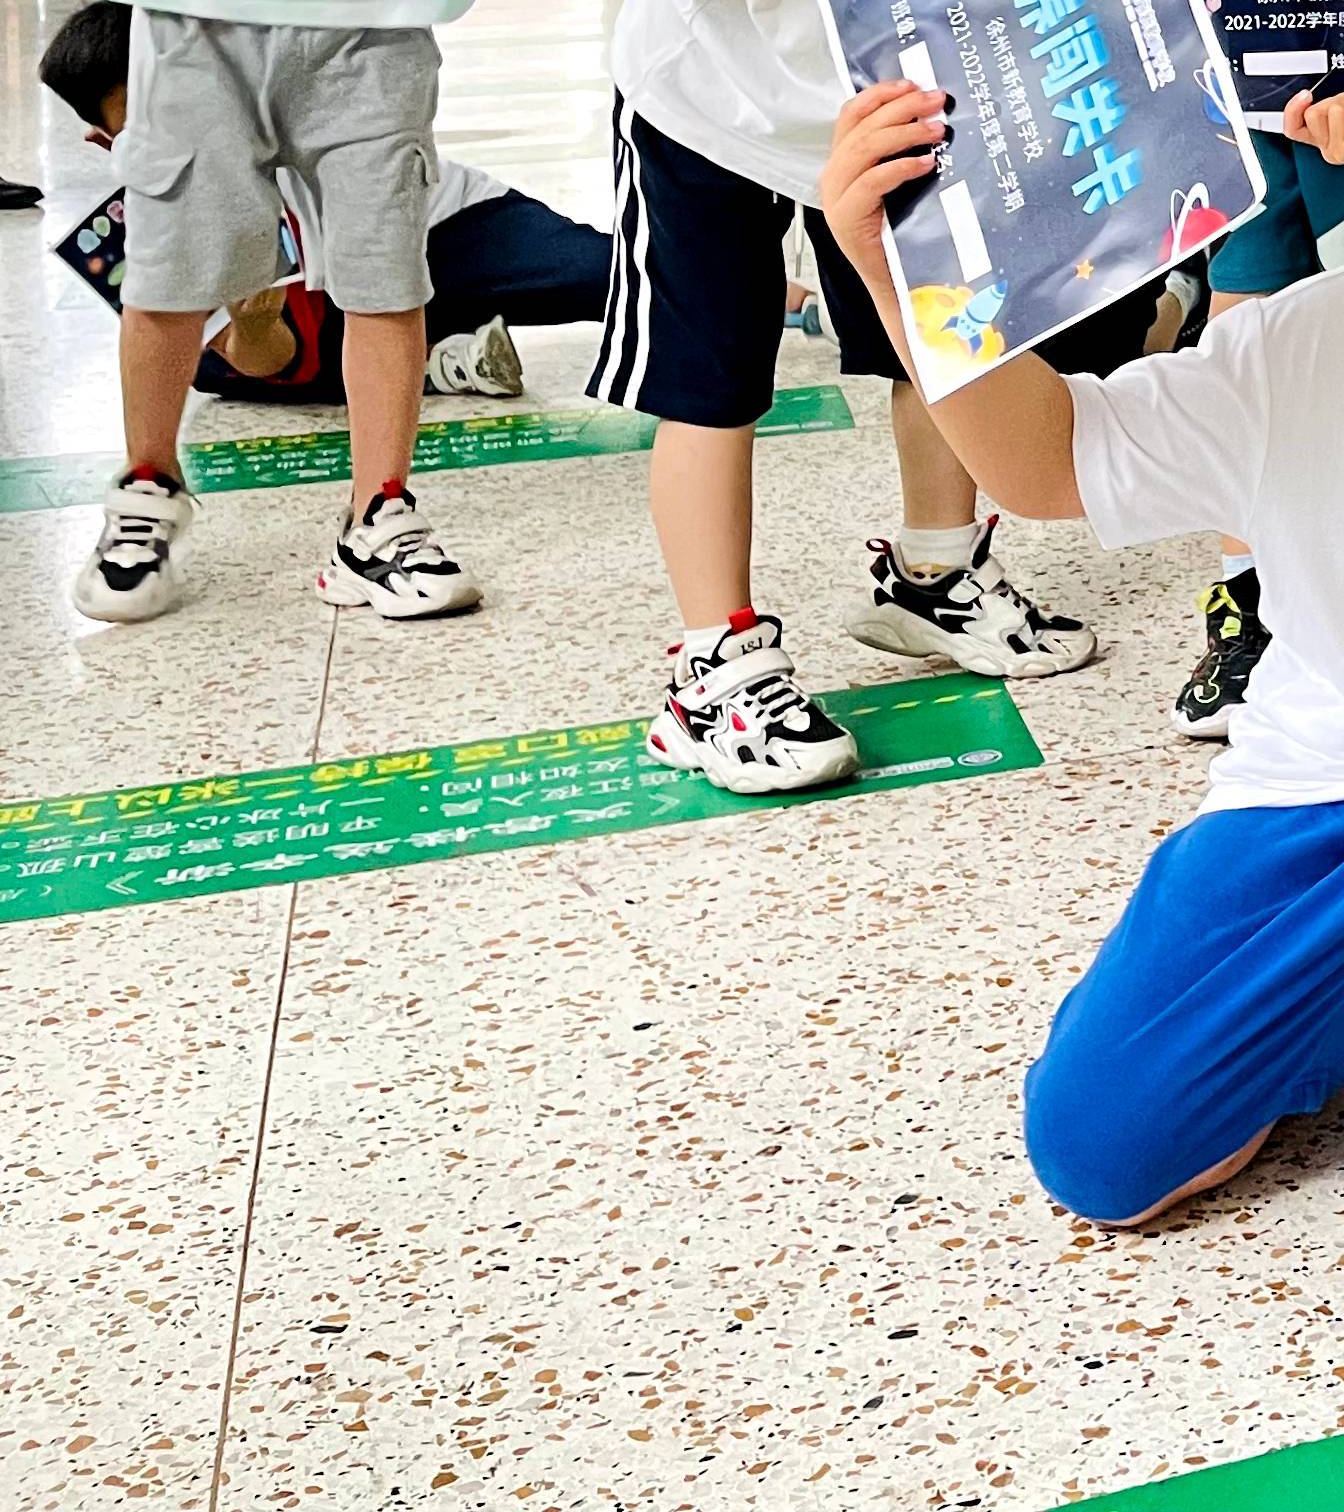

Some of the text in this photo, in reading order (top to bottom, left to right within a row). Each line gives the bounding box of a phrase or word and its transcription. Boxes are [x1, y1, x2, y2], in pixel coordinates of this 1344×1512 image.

[946, 1, 1025, 214] 2021-2022学年度第二学期
[985, 16, 1044, 163] 徐州市新教育学校
